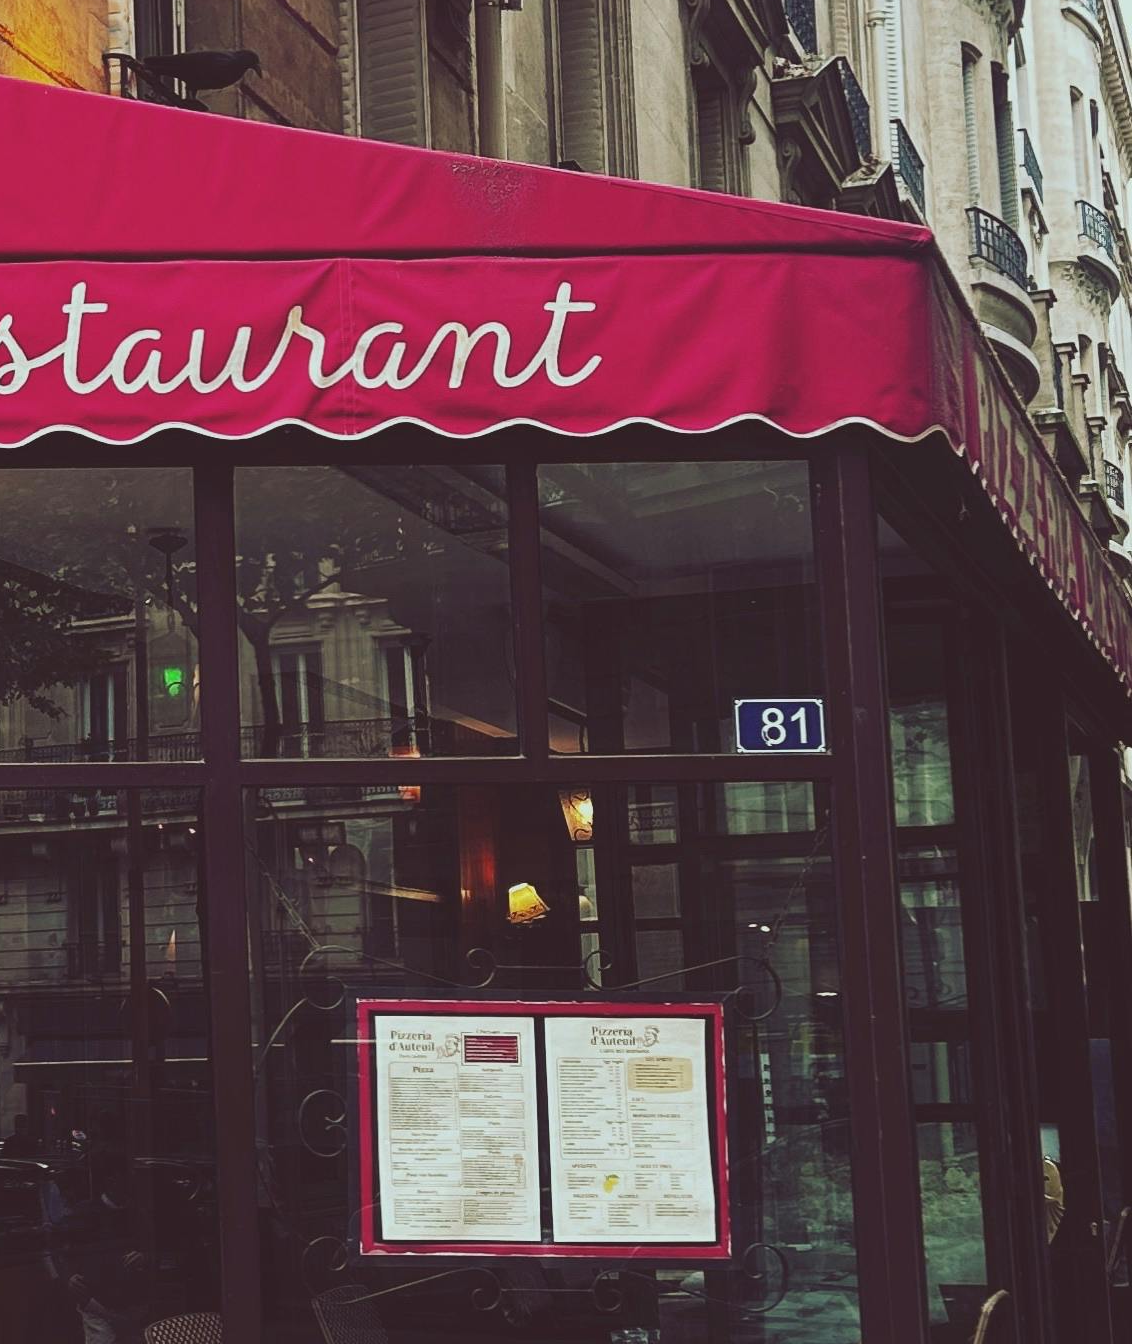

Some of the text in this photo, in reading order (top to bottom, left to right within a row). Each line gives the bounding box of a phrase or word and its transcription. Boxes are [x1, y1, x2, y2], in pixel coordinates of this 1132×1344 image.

[760, 706, 809, 747] 81
[389, 1030, 432, 1041] Pizzeria
[590, 1025, 633, 1037] Pizzeria
